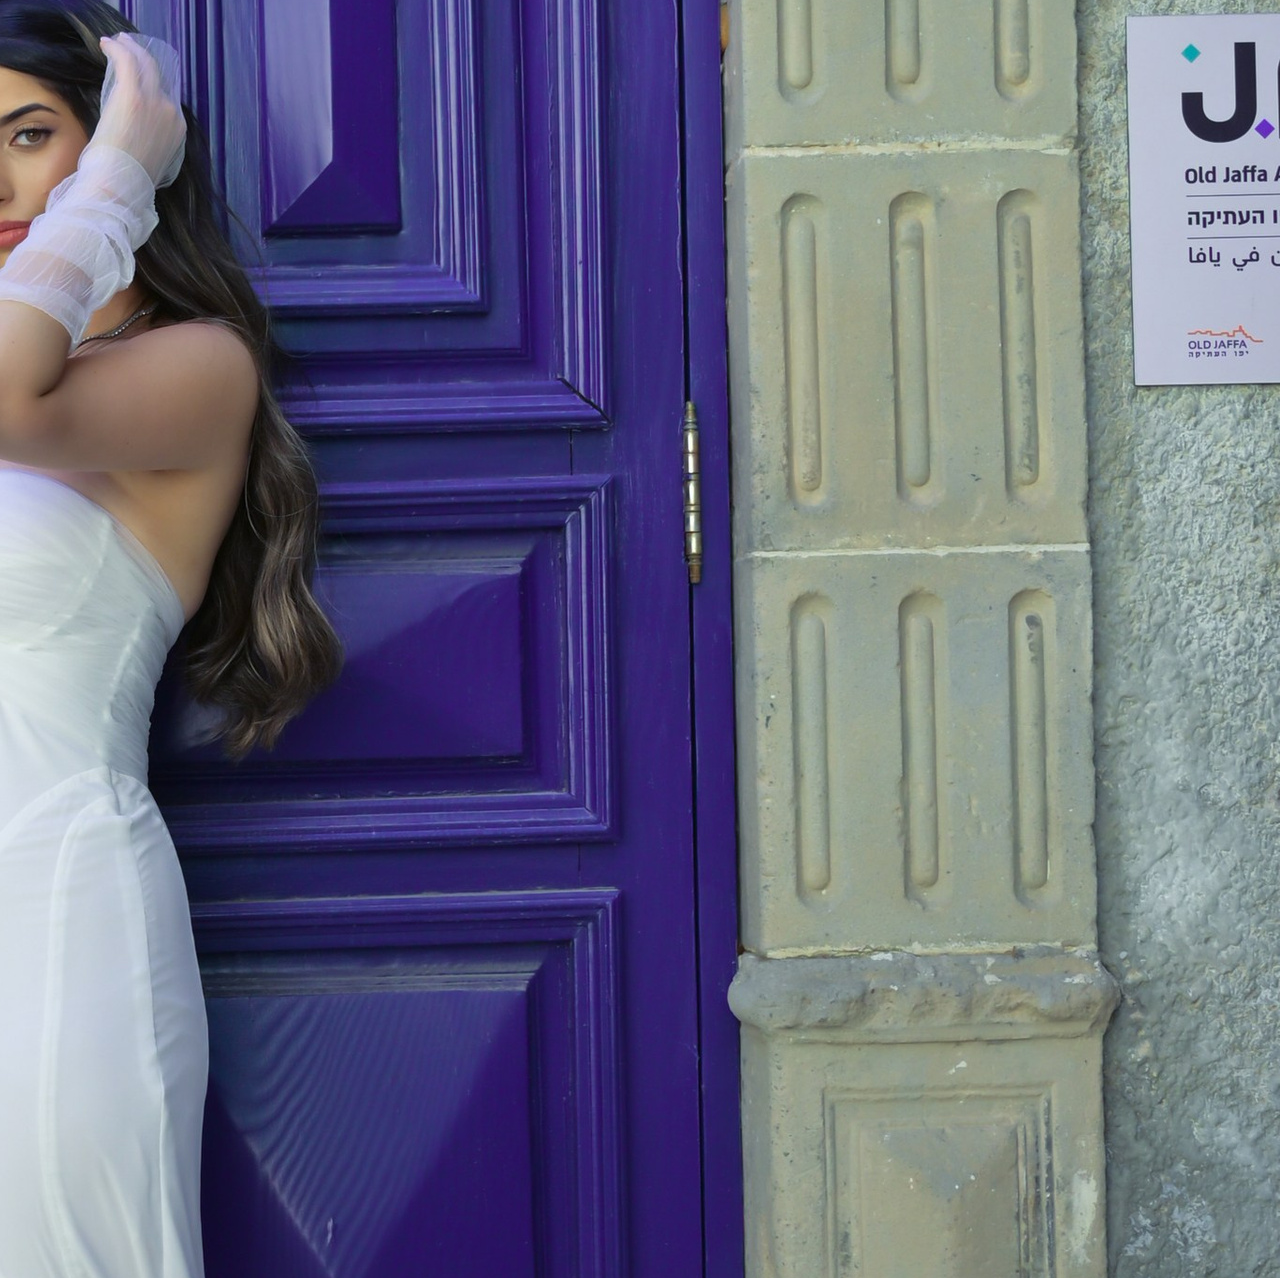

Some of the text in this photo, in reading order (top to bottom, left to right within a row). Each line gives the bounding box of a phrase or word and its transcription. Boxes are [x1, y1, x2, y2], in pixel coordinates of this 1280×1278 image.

[1185, 166, 1217, 184] Old
[1223, 165, 1268, 183] Jaffa
[1187, 210, 1265, 229] העתיקה
[1188, 246, 1221, 268] يافا
[1232, 246, 1260, 272] في
[1188, 339, 1248, 350] OLD JAFFA
